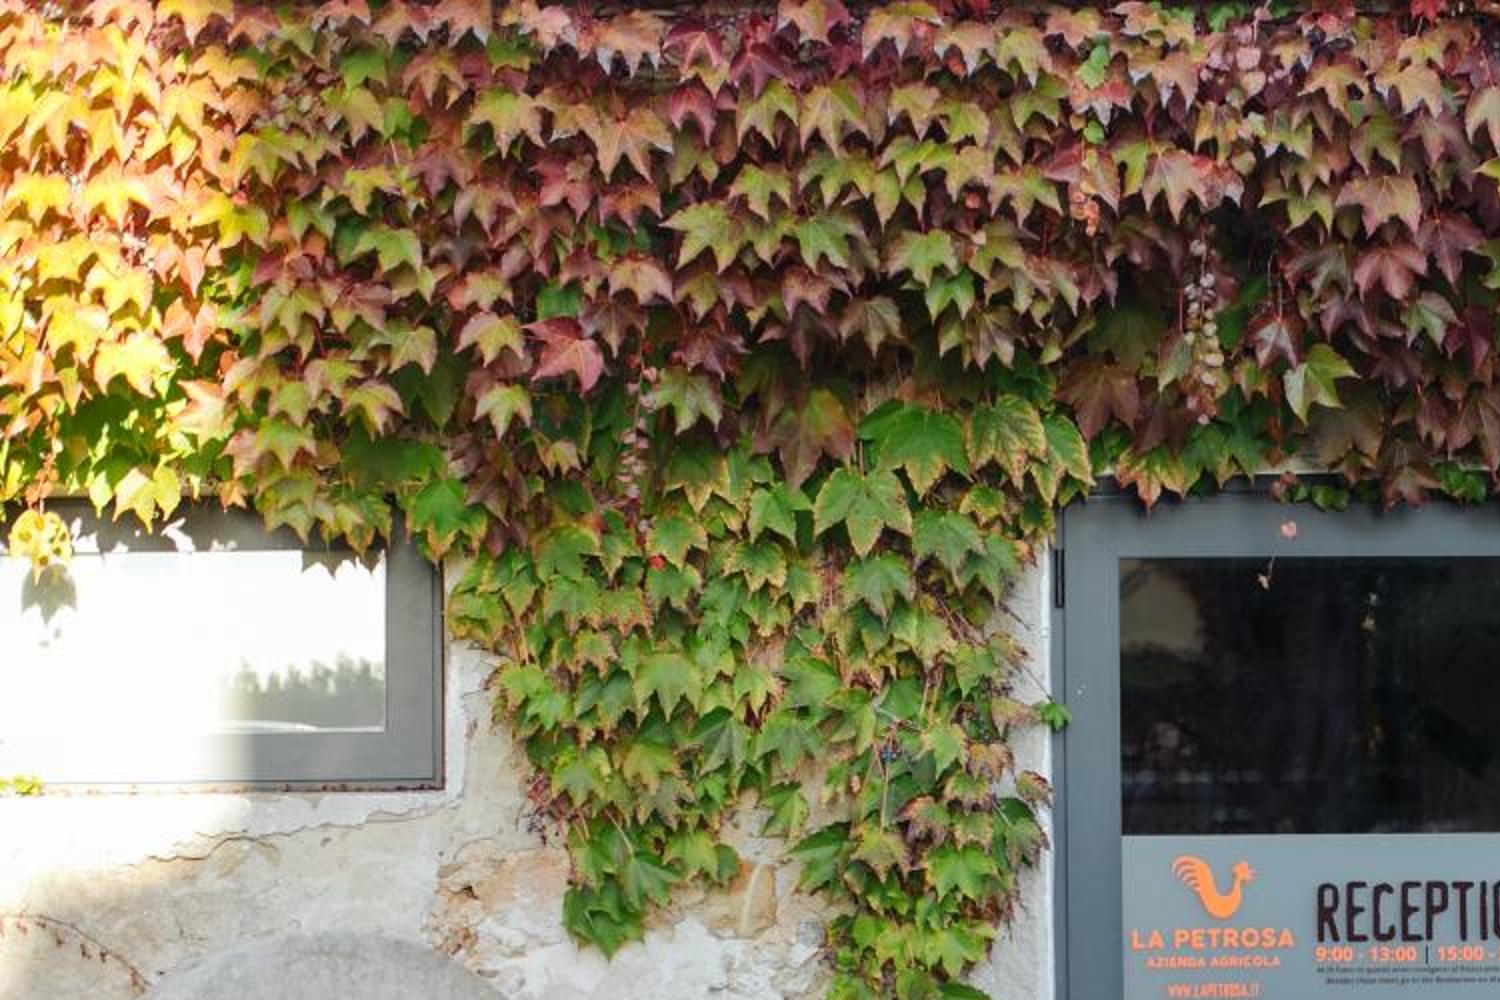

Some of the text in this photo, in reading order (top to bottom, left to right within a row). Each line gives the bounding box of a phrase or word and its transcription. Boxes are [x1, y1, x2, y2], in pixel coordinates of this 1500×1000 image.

[1131, 928, 1295, 950] LA PETROSA
[1315, 946, 1354, 962] 9:00
[1369, 946, 1417, 962] 13:00
[1438, 945, 1484, 962] 15:00
[1147, 955, 1281, 969] AZIENDA AGRICOLA
